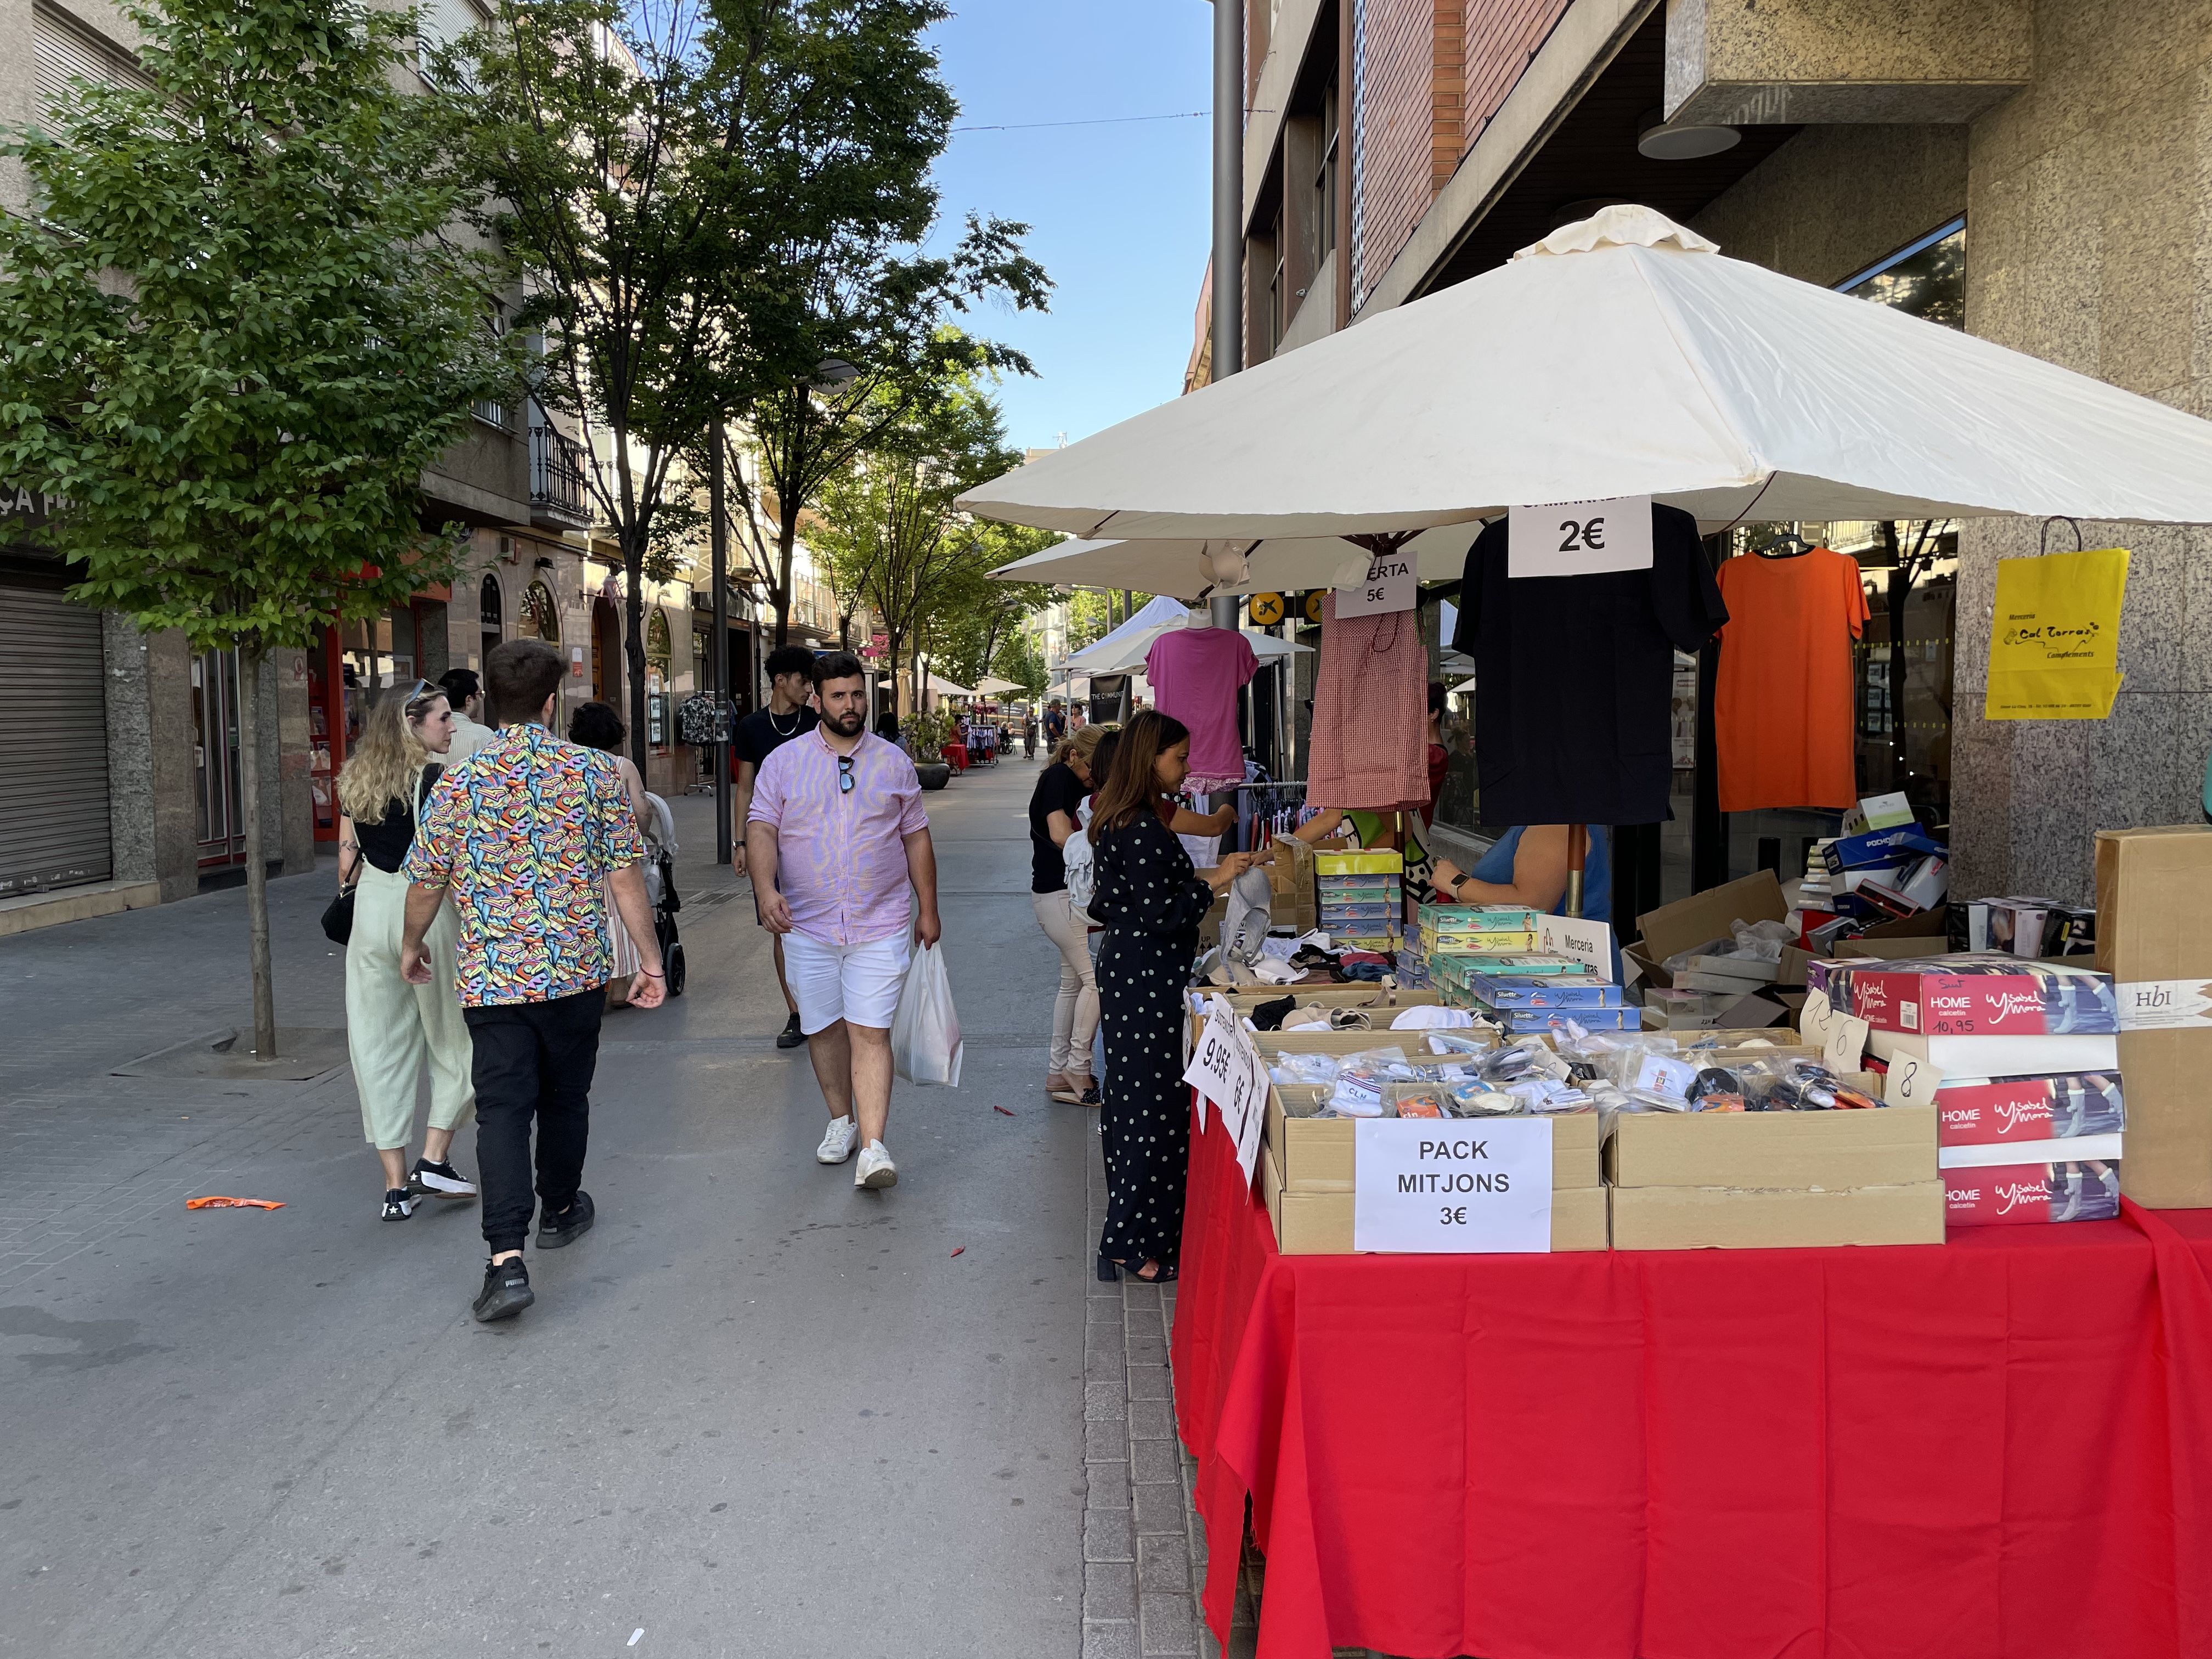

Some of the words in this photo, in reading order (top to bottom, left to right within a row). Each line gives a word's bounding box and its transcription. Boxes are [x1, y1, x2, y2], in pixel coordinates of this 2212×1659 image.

[1559, 517, 1605, 552] 2€
[1367, 587, 1385, 602] 5€
[2047, 626, 2091, 638] Torras
[1931, 997, 1971, 1008] HOME
[1985, 990, 2047, 1024] Ysabel
[2005, 1002, 2046, 1014] Mora
[1933, 1020, 1974, 1034] 10,95
[1836, 1019, 1853, 1056] 6
[1203, 1037, 1231, 1084] 9.95€
[1900, 1062, 1917, 1098] 8
[1234, 1074, 1245, 1115] 6€
[1942, 1109, 1982, 1122] HOME
[1994, 1097, 2055, 1134] Ysabel
[2013, 1111, 2053, 1124] Mora
[1420, 1141, 1489, 1160] PACK
[1398, 1173, 1509, 1193] MITJONS
[1995, 1180, 2054, 1215] Ysabel
[2013, 1193, 2052, 1205] Mora
[1440, 1207, 1468, 1226] 3€
